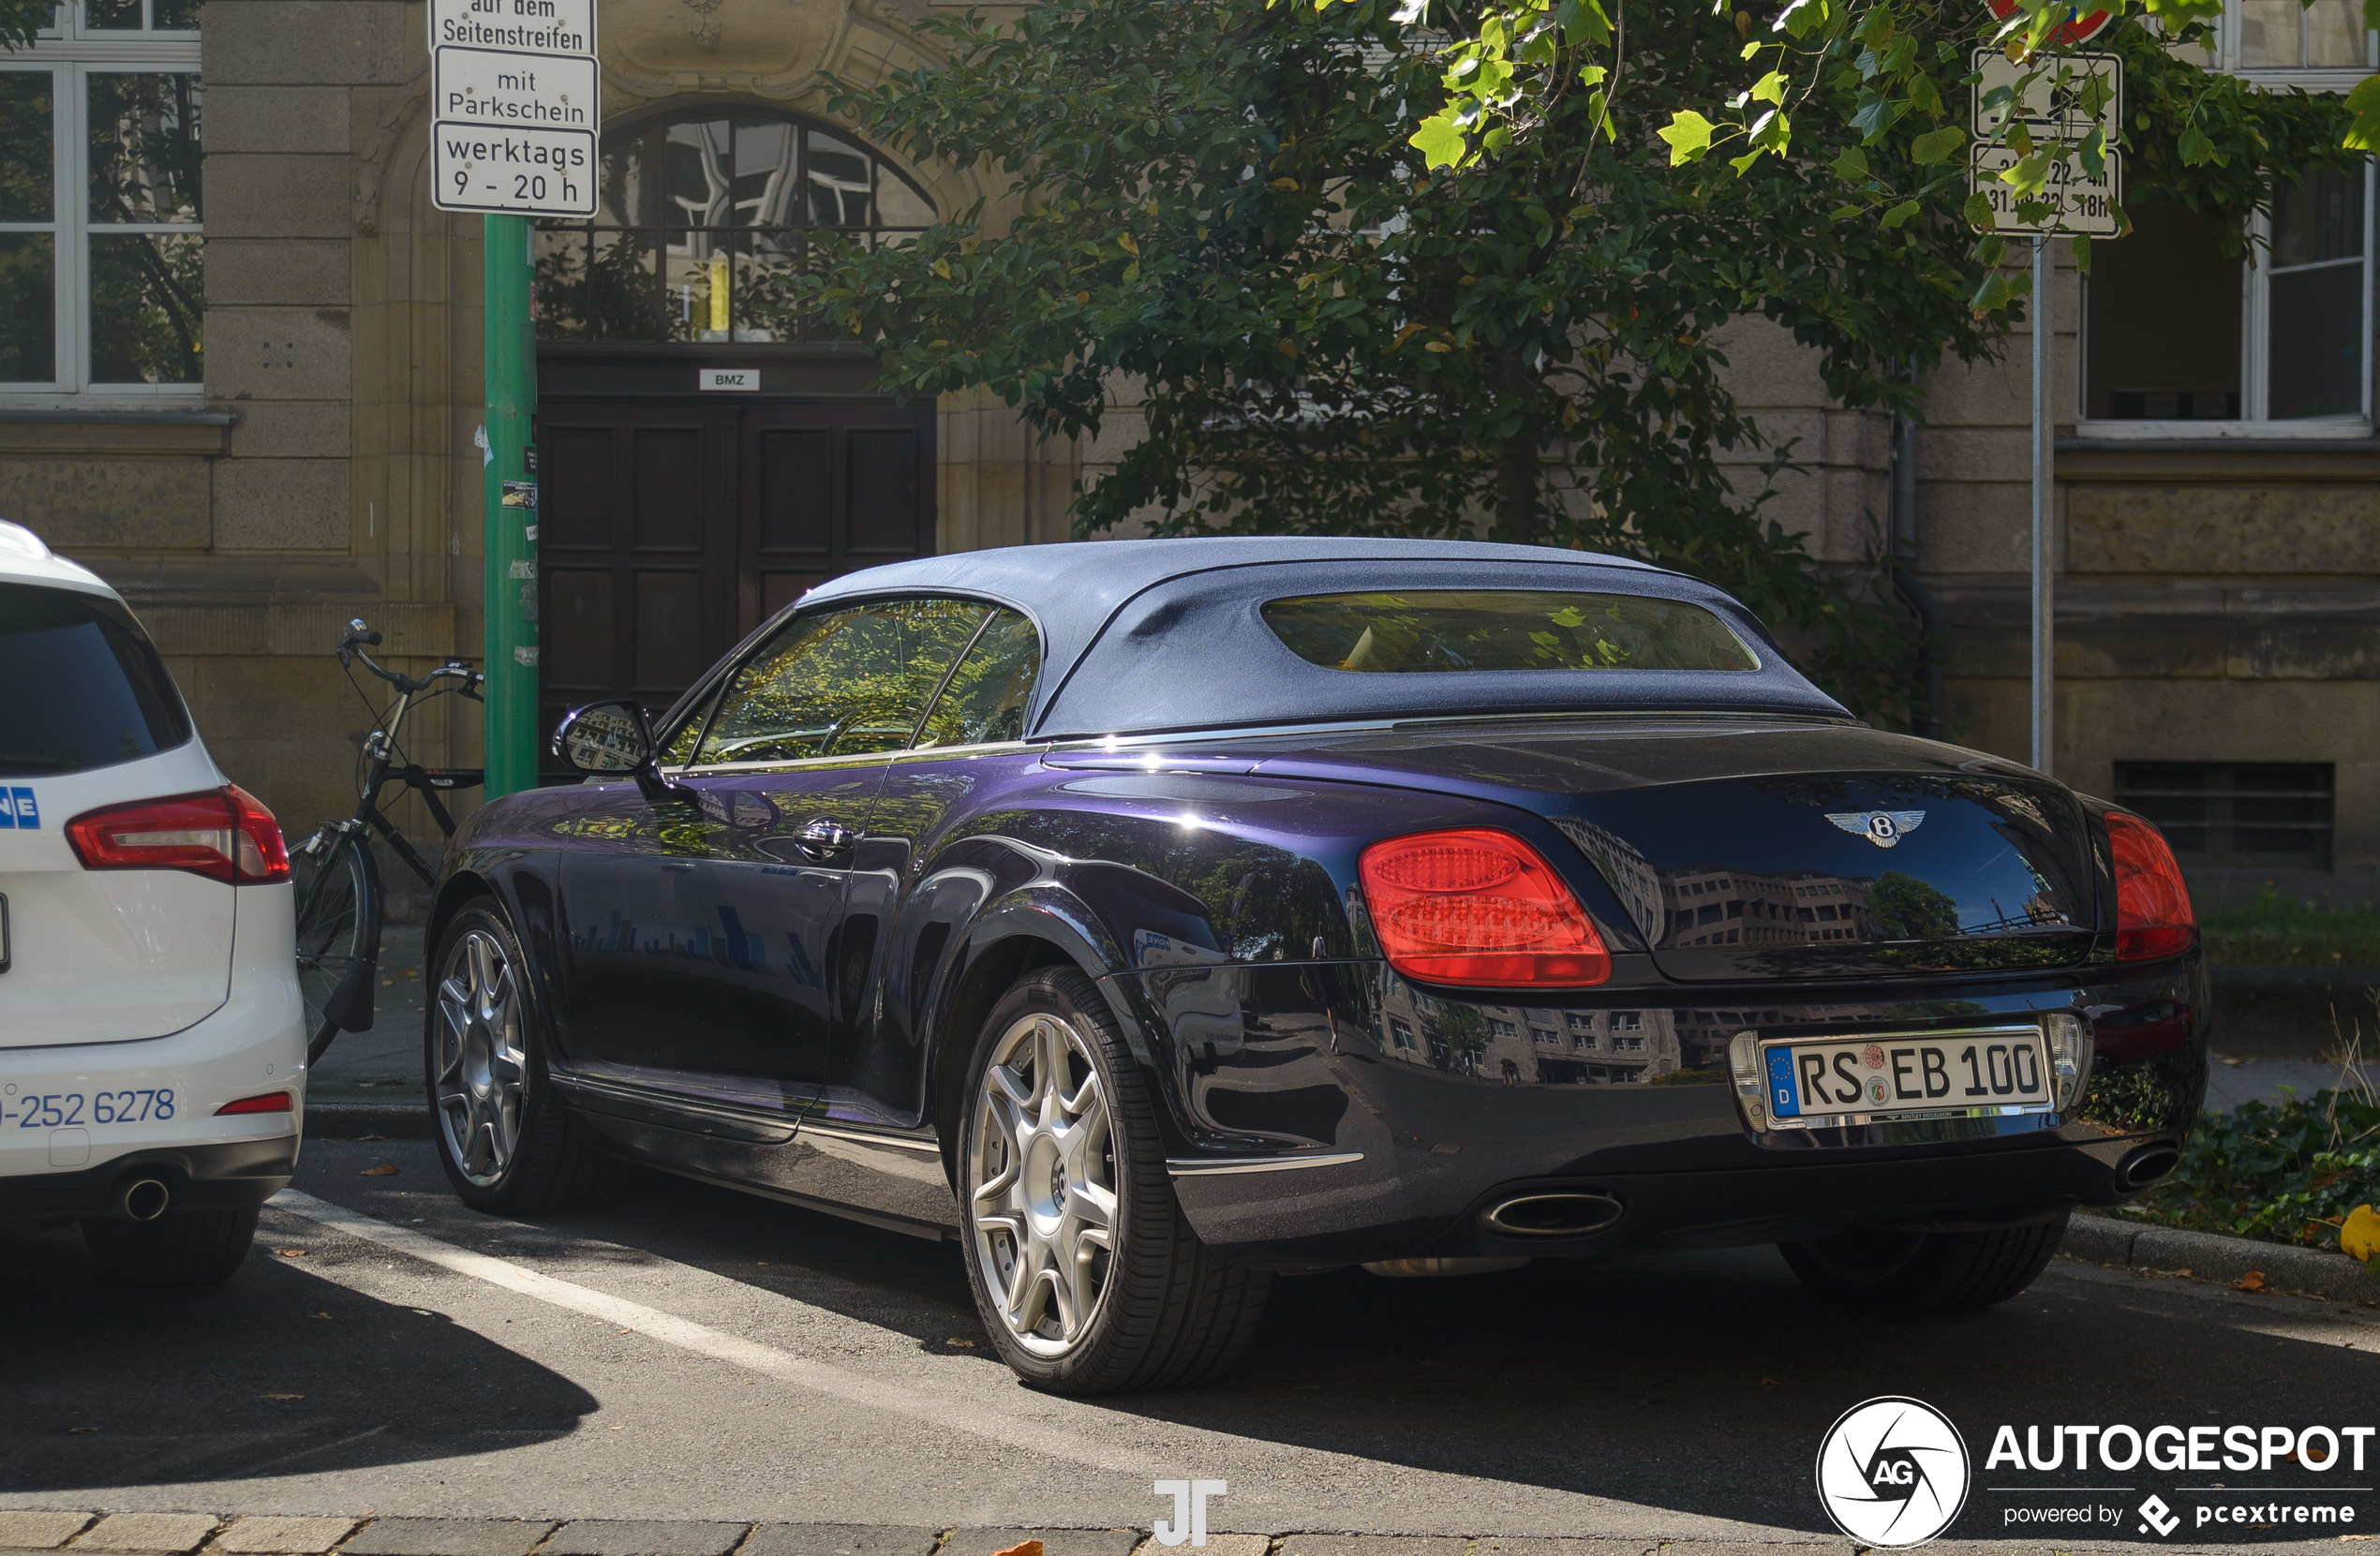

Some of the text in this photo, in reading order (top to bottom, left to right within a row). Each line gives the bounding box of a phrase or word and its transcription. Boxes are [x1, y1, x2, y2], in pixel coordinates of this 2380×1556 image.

[514, 0, 555, 18] dem
[443, 19, 583, 50] Seitenstreifen
[498, 70, 536, 91] mit
[449, 93, 585, 123] Parkschein
[446, 138, 585, 171] werktags
[454, 170, 469, 196] 9
[514, 174, 546, 200] 20
[562, 177, 577, 201] h
[2079, 193, 2108, 217] 18h
[715, 375, 745, 386] BMZ
[1797, 1044, 2040, 1105] RS EB 100
[0, 1089, 176, 1128] -252 6278
[1778, 1089, 1790, 1104] D
